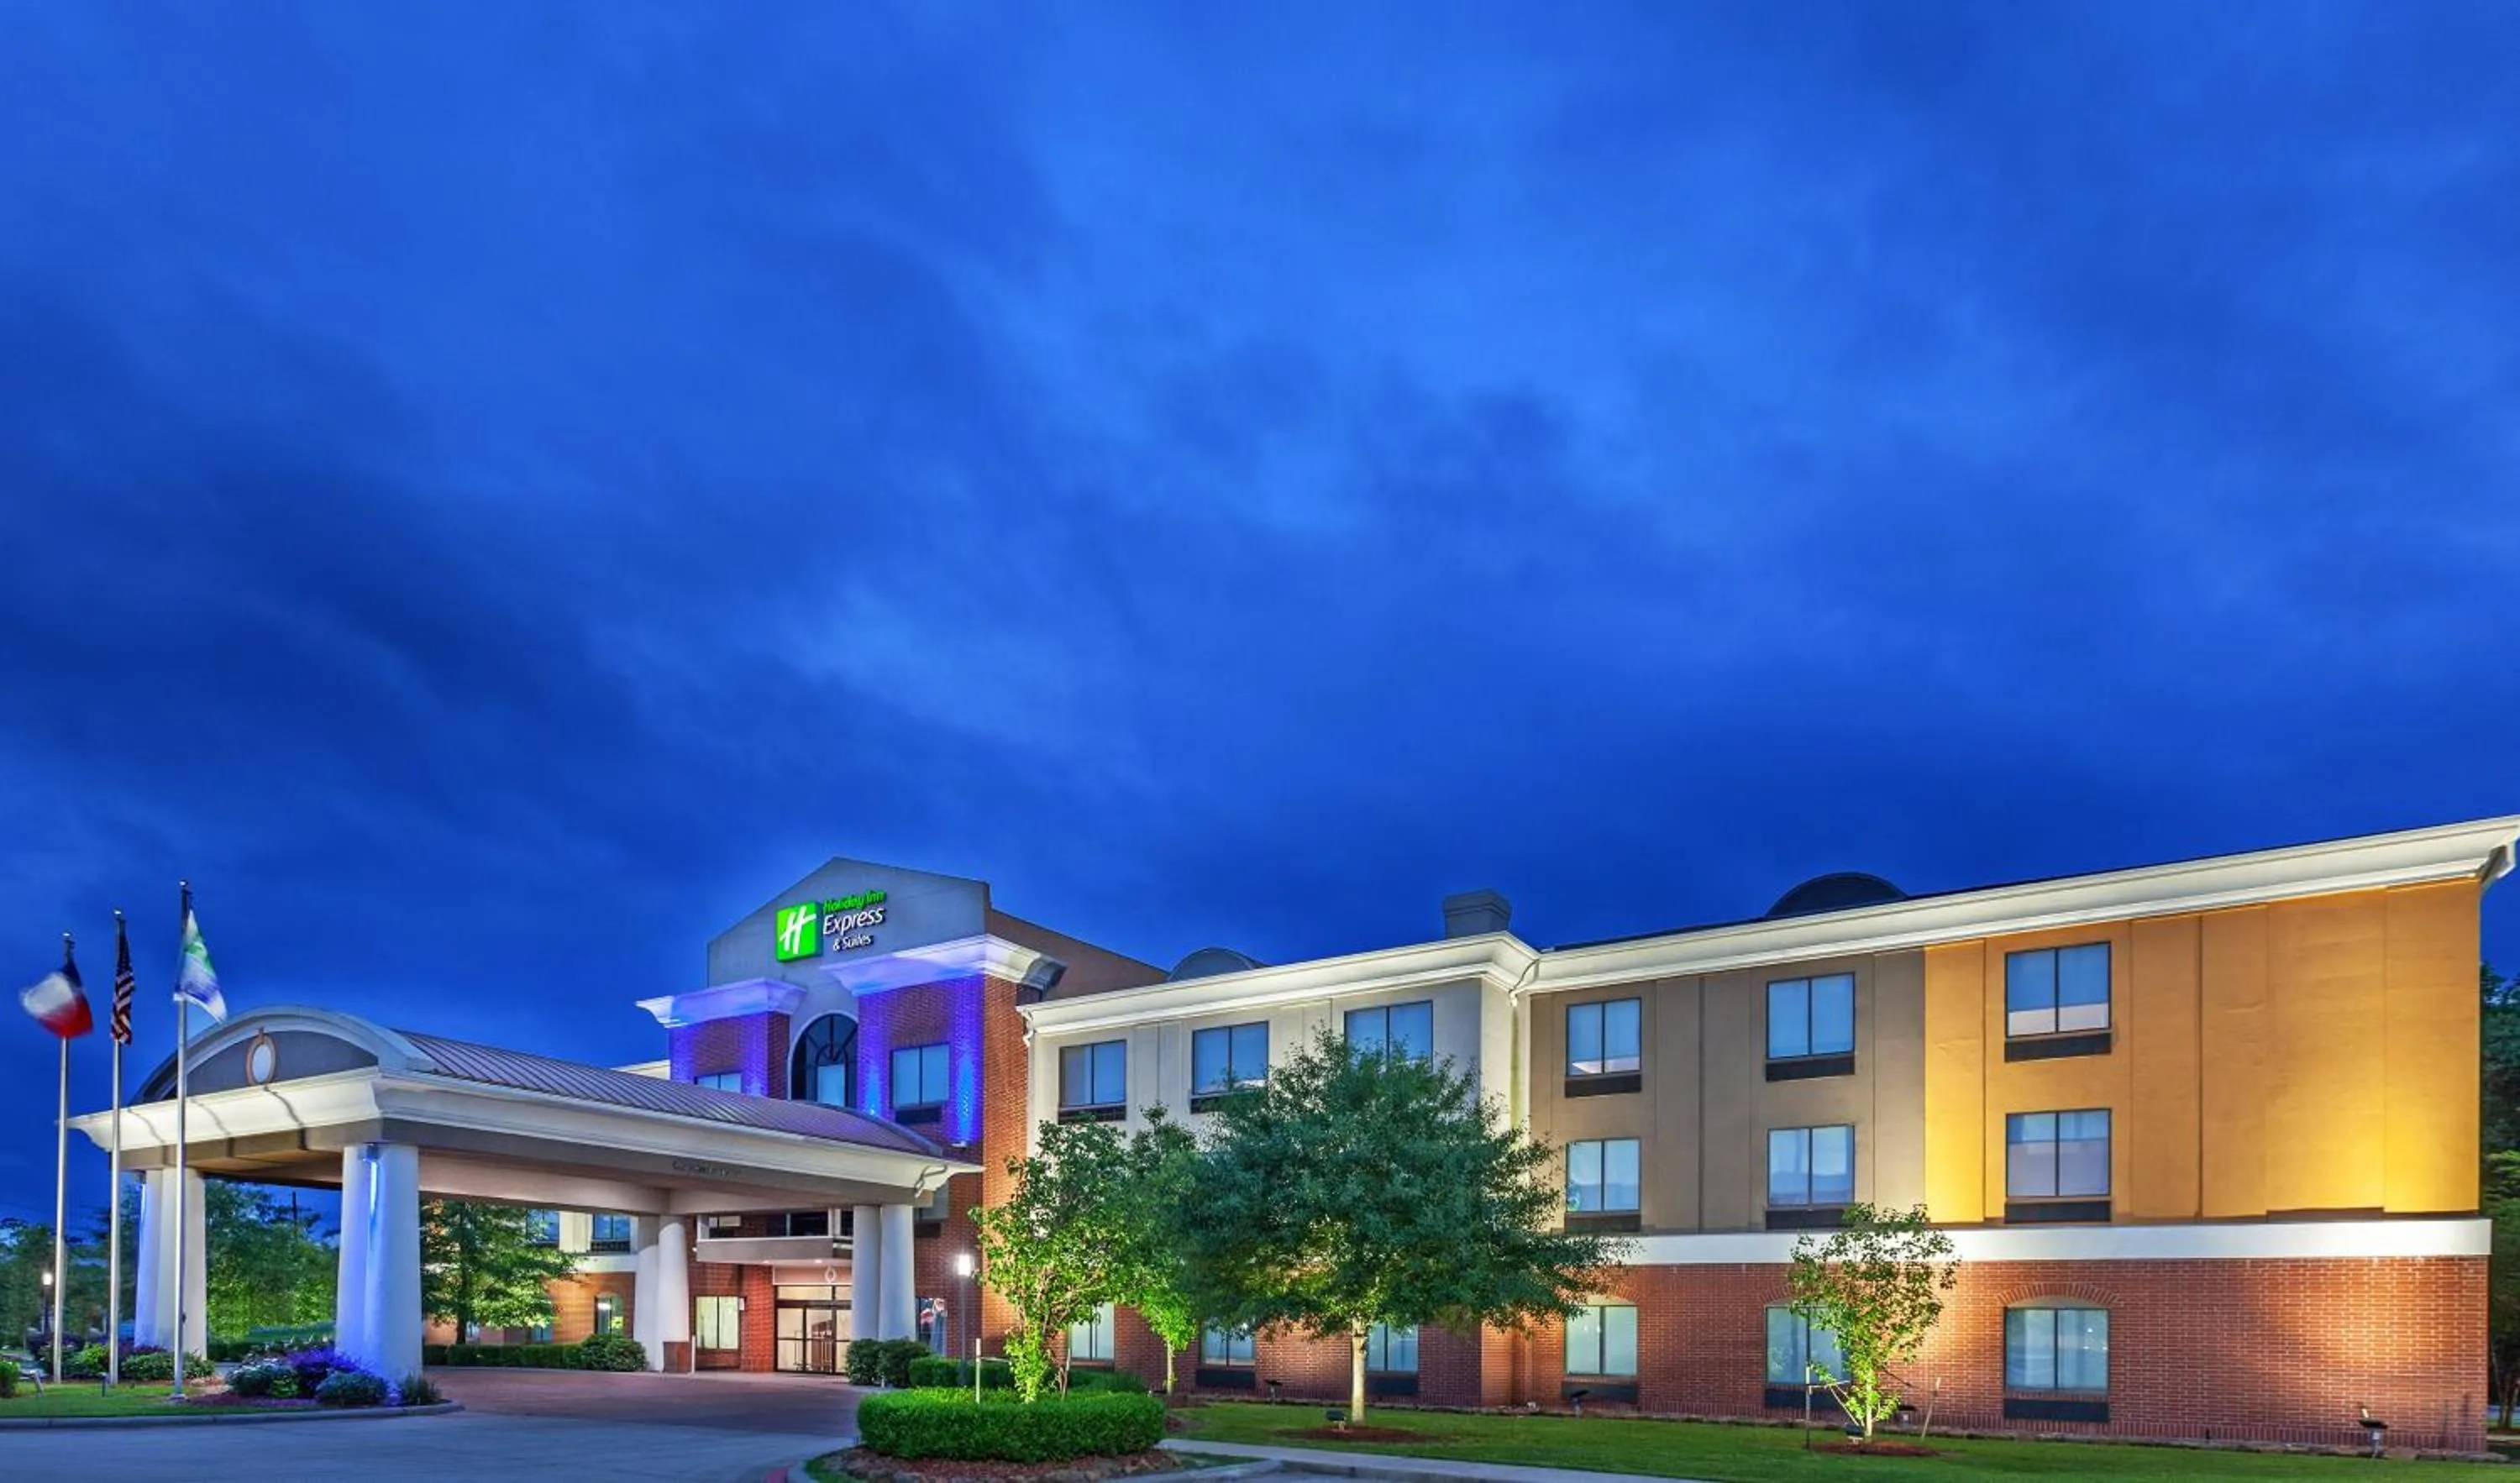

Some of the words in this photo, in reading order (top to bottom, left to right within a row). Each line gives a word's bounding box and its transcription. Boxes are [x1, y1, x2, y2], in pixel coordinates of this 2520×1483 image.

[823, 894, 864, 914] Holiday
[865, 889, 886, 904] Inn
[823, 908, 885, 935] Express
[832, 939, 841, 951] &
[842, 934, 872, 950] Suites
